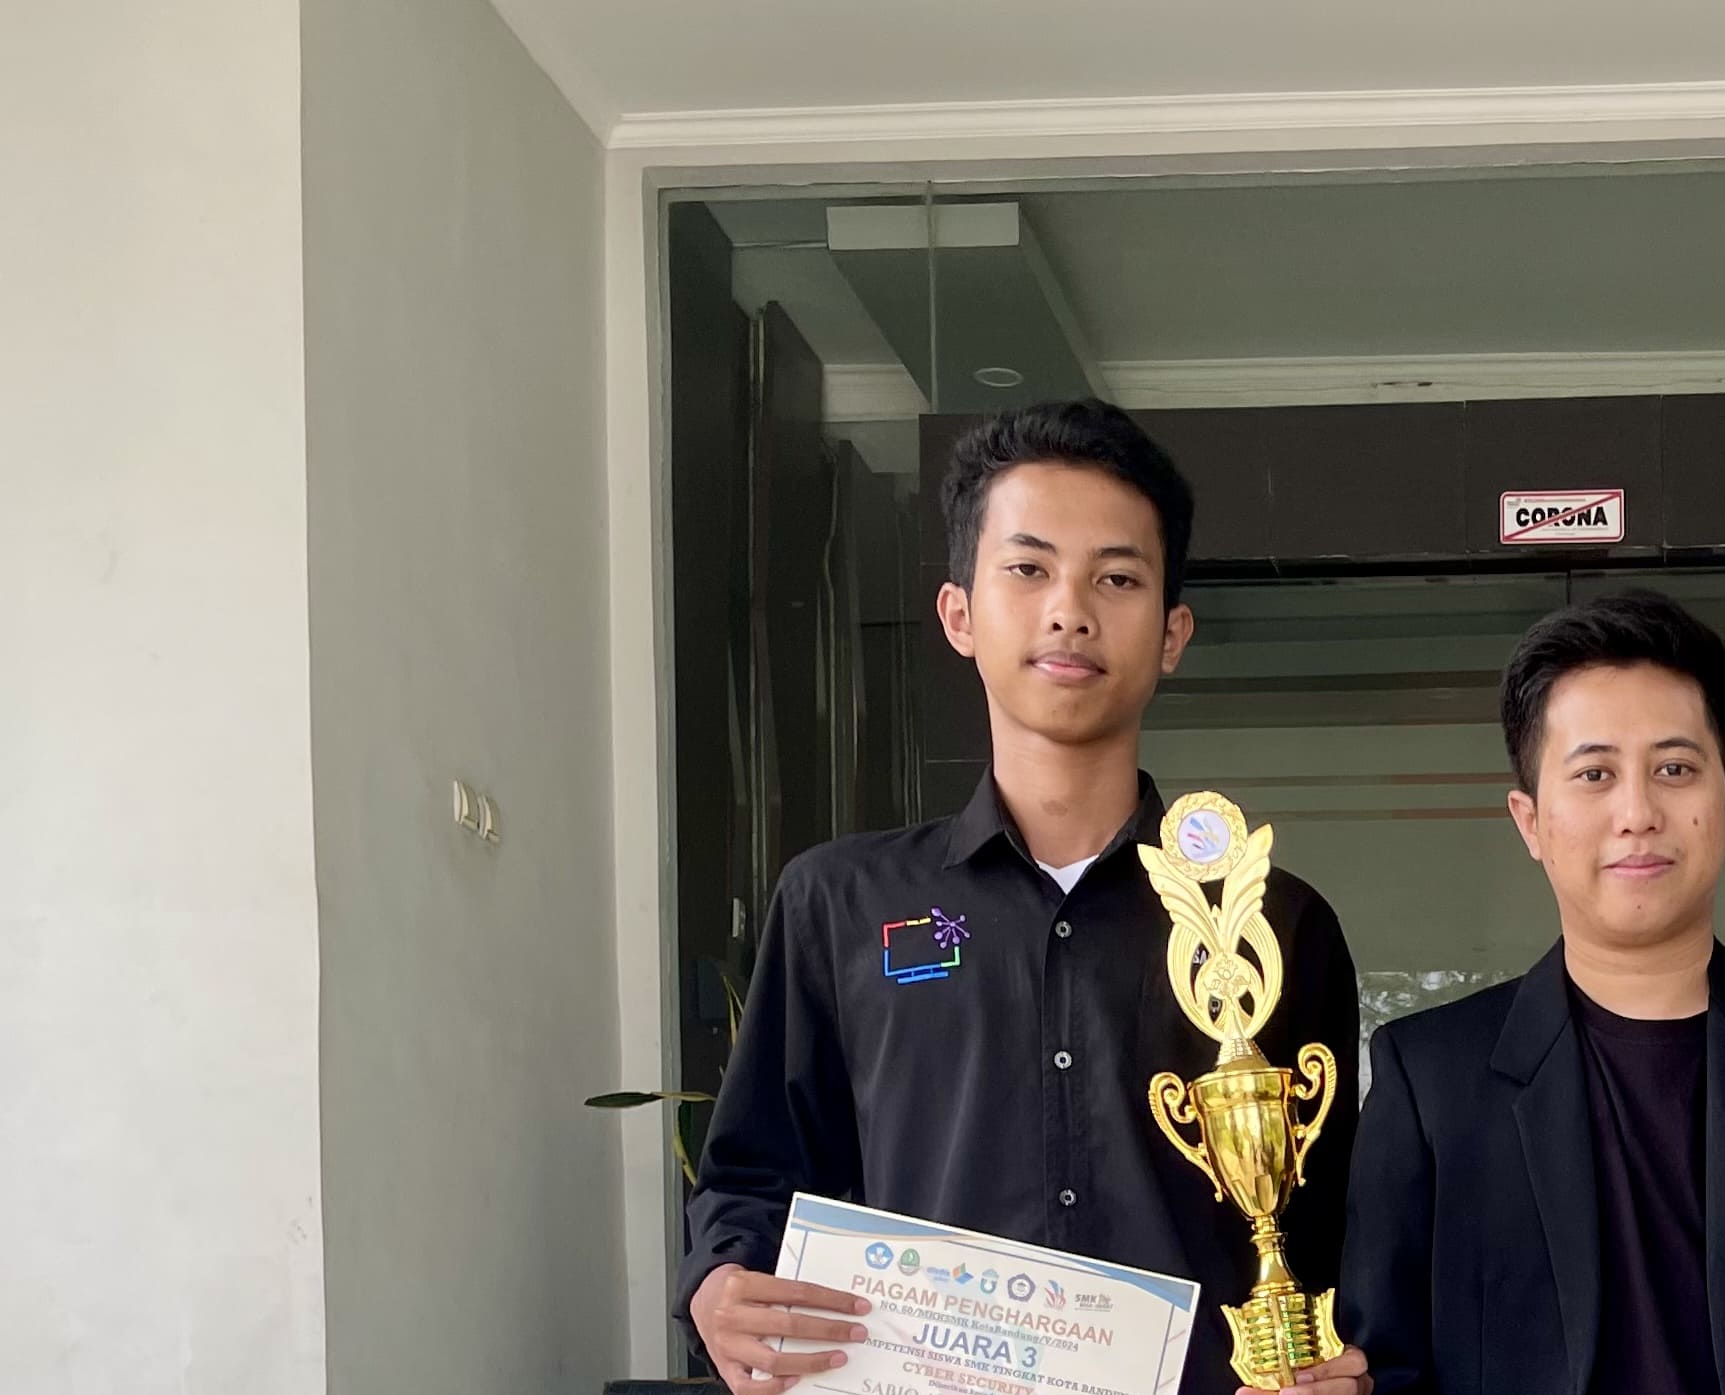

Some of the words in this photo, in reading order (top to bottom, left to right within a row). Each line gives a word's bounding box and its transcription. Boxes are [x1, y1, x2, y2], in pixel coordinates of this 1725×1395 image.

[1516, 507, 1608, 527] CORONA
[850, 1274, 938, 1308] PIAGAM
[943, 1295, 1114, 1347] PENGHARGAAN
[866, 1338, 924, 1358] MPETENSI
[928, 1352, 961, 1367] SISWA
[964, 1360, 991, 1372] SMK
[992, 1365, 1045, 1383] TINGKAT
[1046, 1377, 1078, 1391] KOTA
[912, 1323, 1012, 1364] JUARA
[1021, 1346, 1038, 1368] 3
[902, 1361, 955, 1381] CYBER
